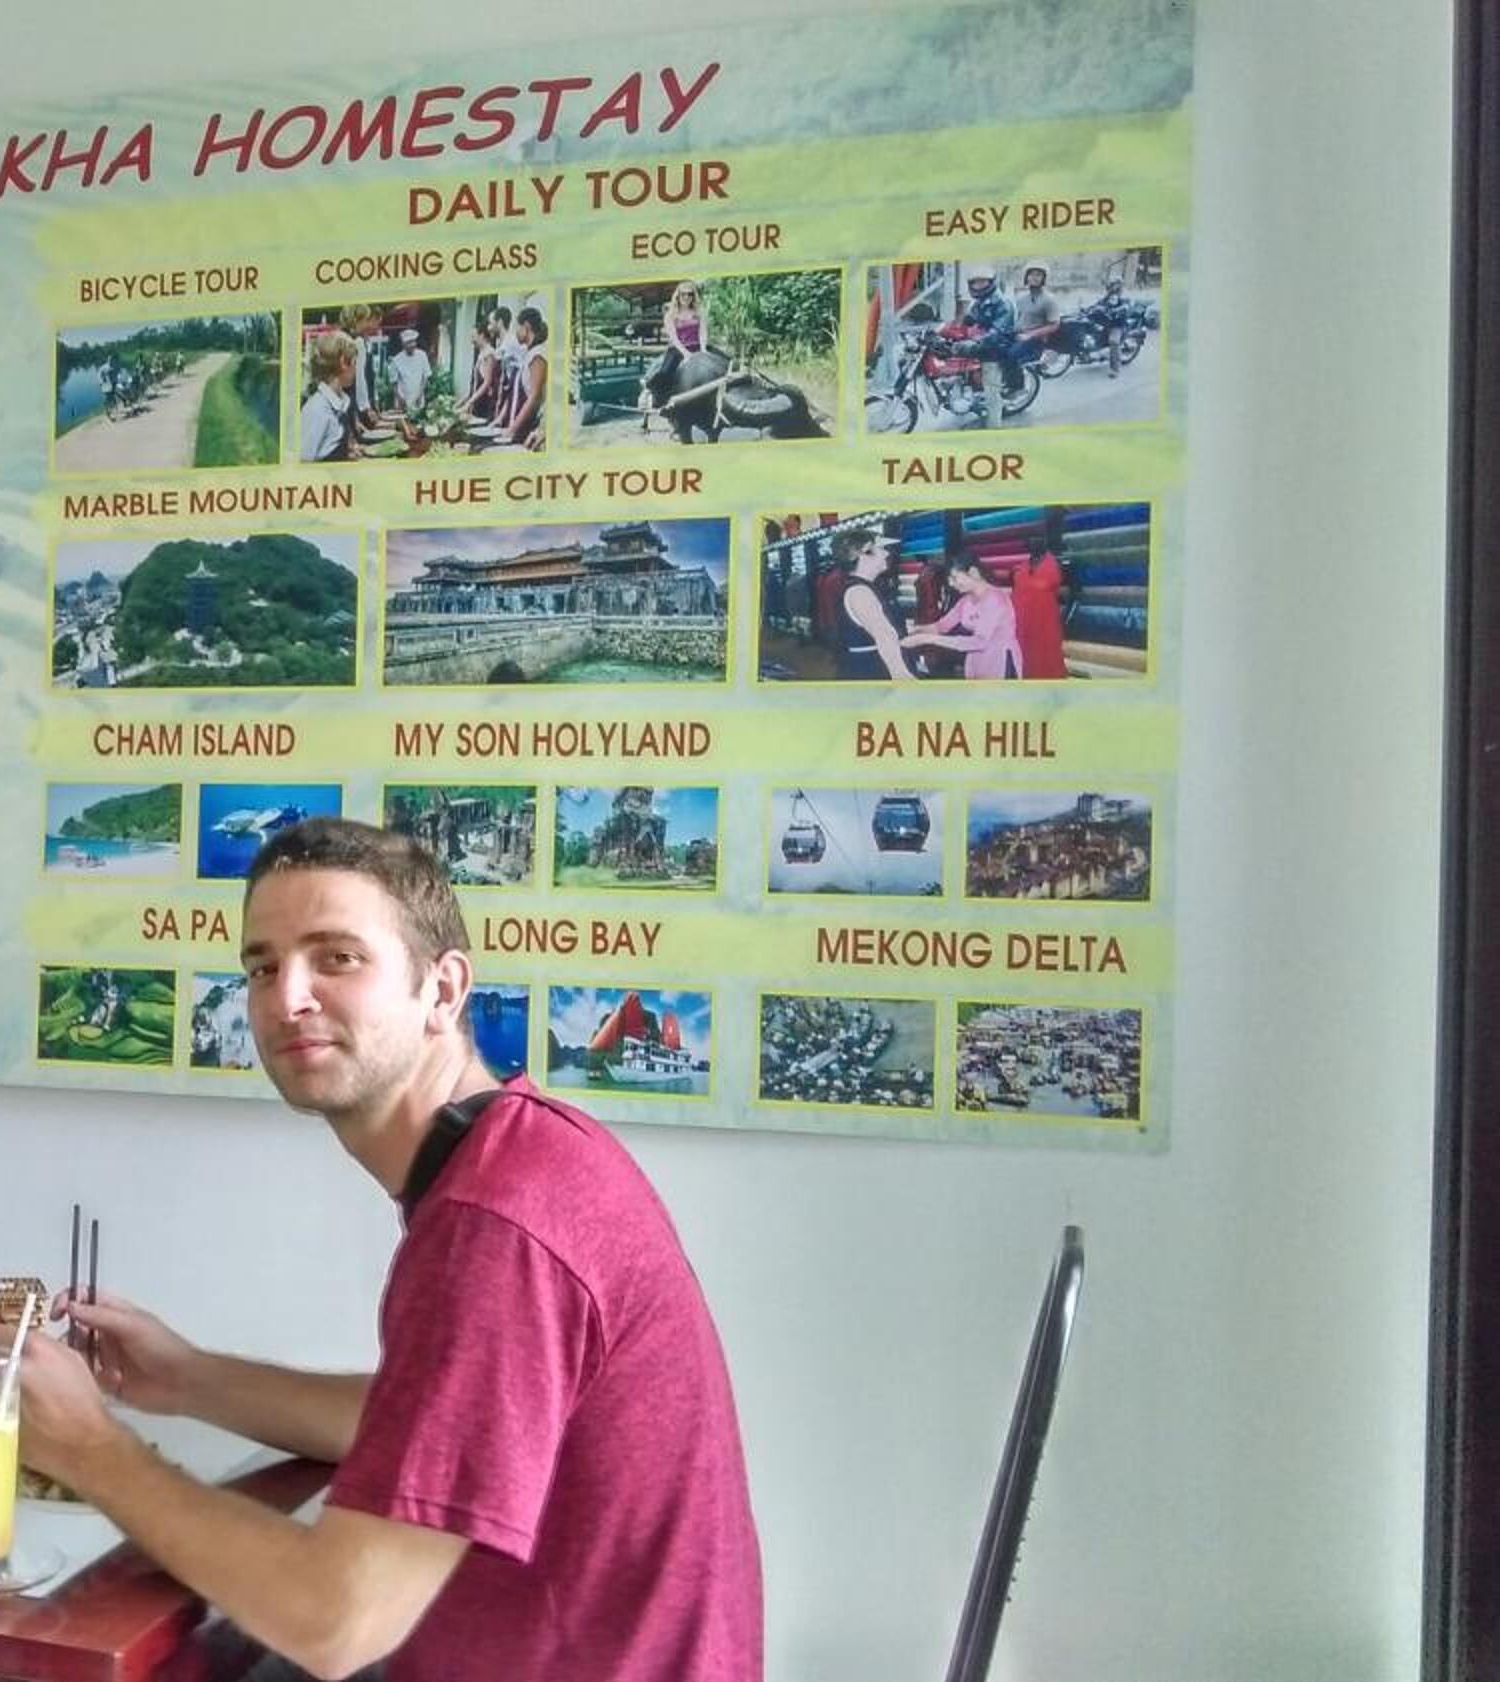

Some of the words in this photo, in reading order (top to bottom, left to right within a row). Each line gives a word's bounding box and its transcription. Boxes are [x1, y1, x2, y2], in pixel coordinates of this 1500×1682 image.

[193, 62, 721, 177] HOMESTAY
[408, 174, 565, 226] DAILY
[586, 160, 730, 209] TOUR
[925, 206, 1010, 238] EASY
[1022, 198, 1116, 231] RIDER
[631, 229, 696, 259] ECO
[705, 223, 781, 254] TOUR
[315, 249, 444, 285] COOKING
[452, 243, 538, 275] CLASS
[80, 272, 186, 303] BICYCLE
[194, 266, 260, 295] TOUR
[414, 477, 492, 505] HUE
[505, 473, 589, 501] CITY
[602, 468, 703, 497] TOUR
[881, 454, 1025, 486] TAILOR
[64, 491, 180, 519] MARBLE
[189, 484, 353, 515] MOUNTAIN
[93, 723, 183, 756] CHAM
[193, 723, 296, 756] ISLAND
[394, 722, 444, 757] MY
[455, 722, 520, 757] SON
[533, 721, 711, 758] HOLYLAND
[855, 720, 904, 758] BA
[916, 721, 972, 758] NA
[984, 721, 1056, 758] HILL
[142, 908, 181, 940] SA
[190, 909, 230, 942] PA
[483, 917, 579, 954] LONG
[590, 920, 661, 957] BAY
[815, 926, 992, 969] MEKONG
[1006, 932, 1128, 974] DELTA
